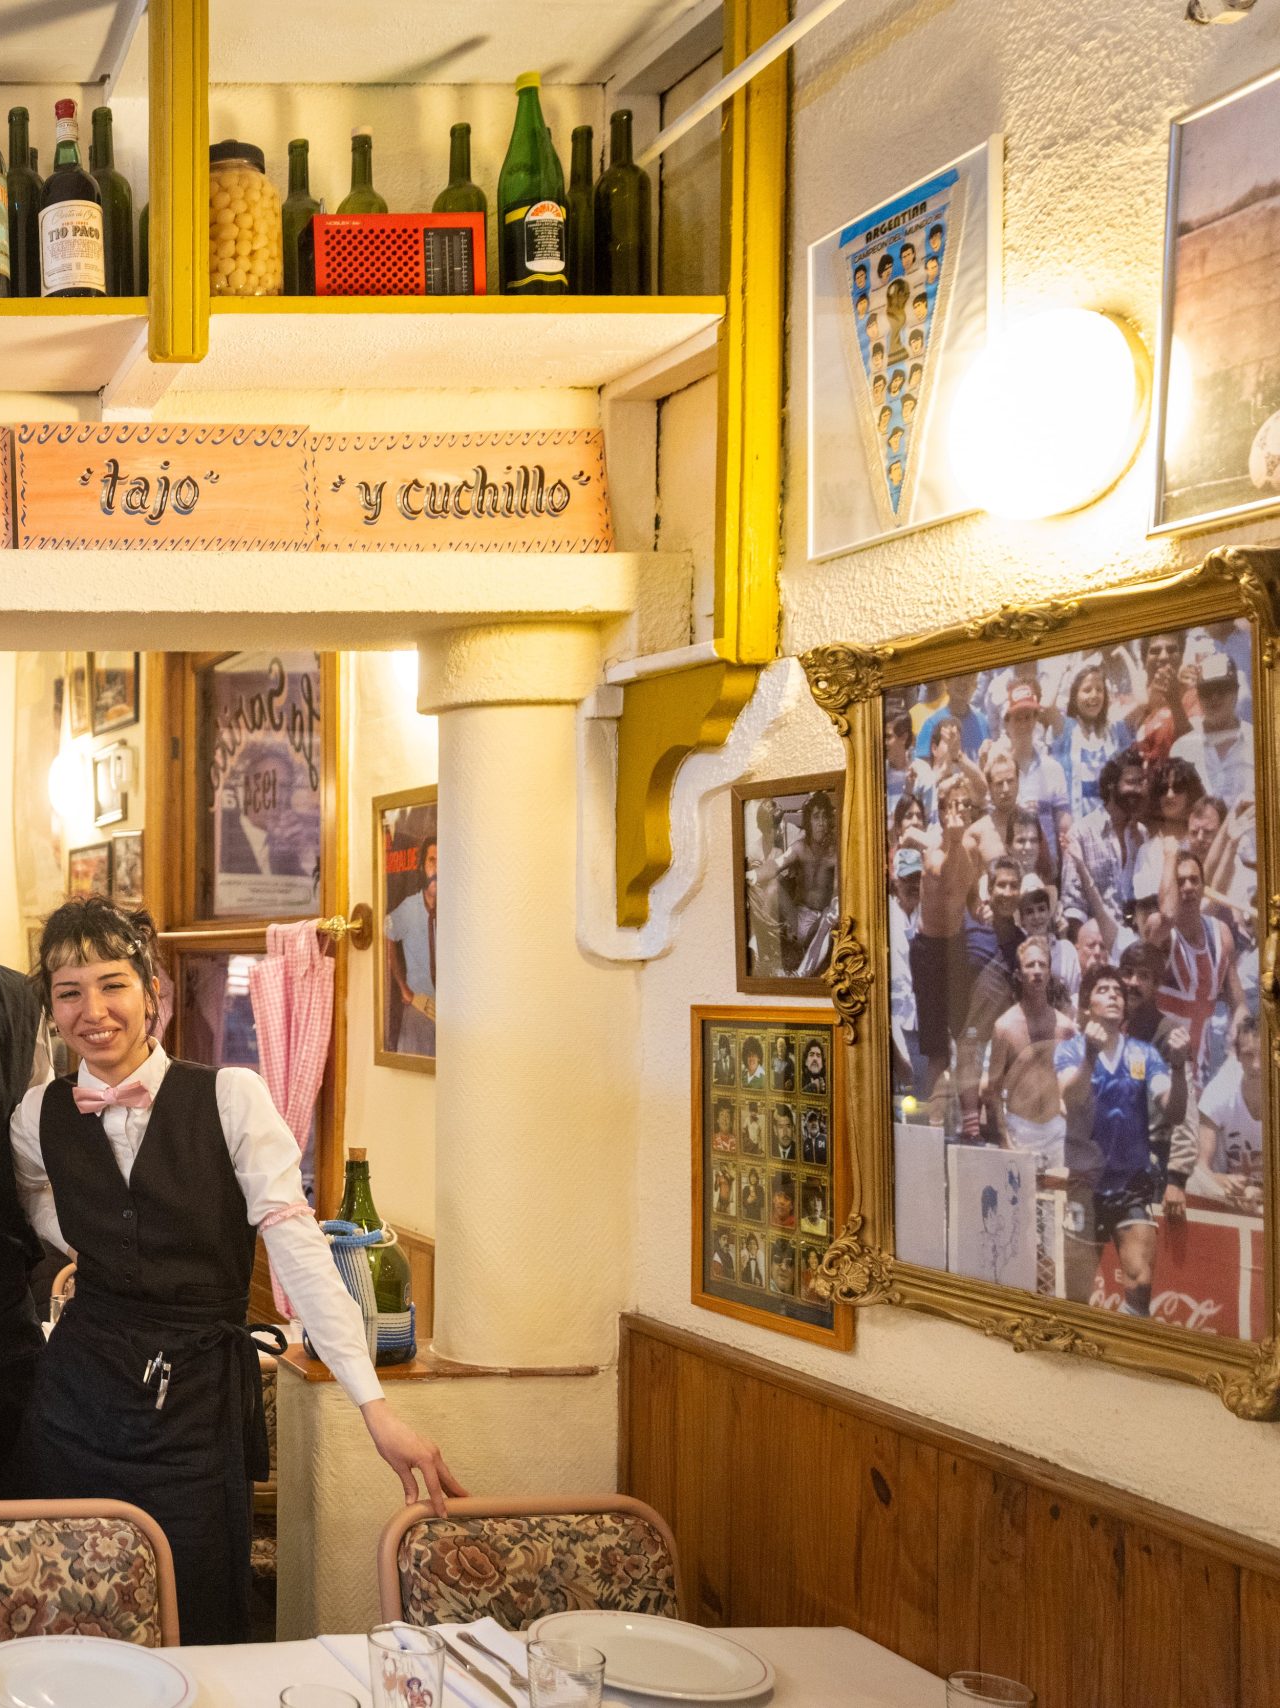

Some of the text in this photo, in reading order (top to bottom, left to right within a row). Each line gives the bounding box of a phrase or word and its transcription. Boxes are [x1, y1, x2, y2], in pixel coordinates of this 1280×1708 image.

[48, 225, 100, 242] TIO PACO
[864, 200, 928, 244] ARGENTINA
